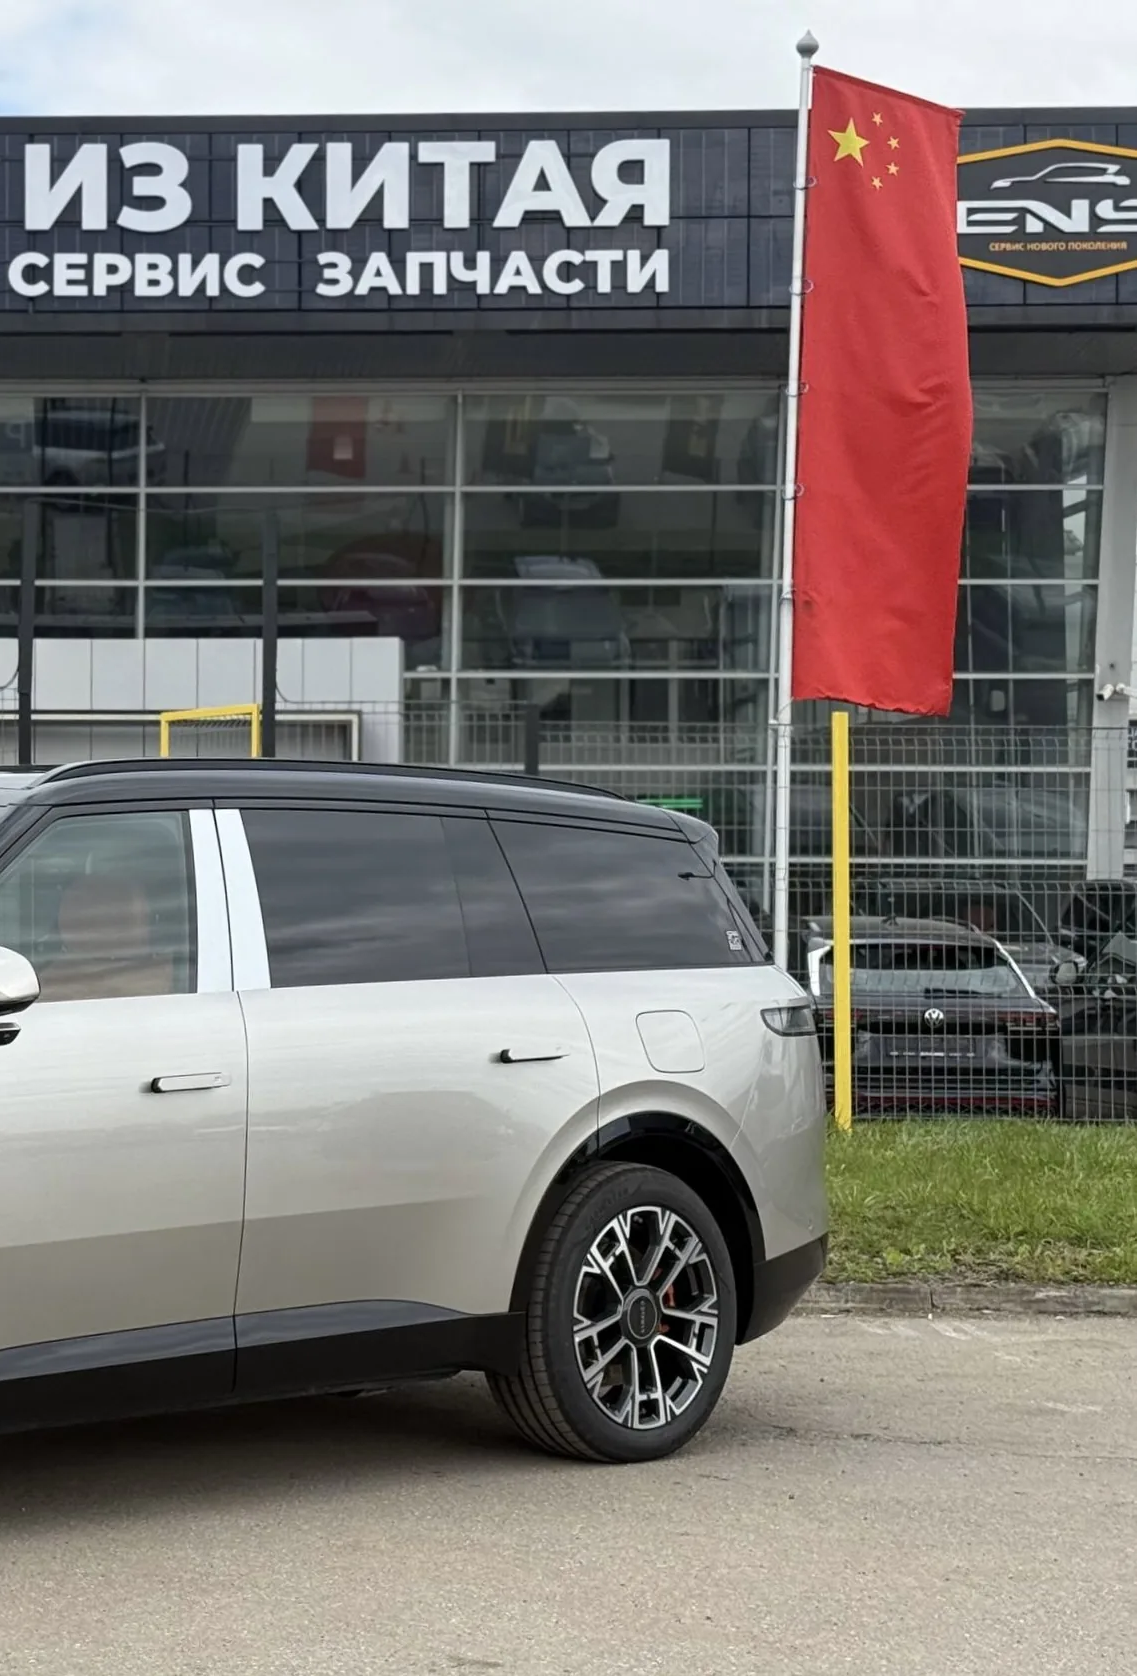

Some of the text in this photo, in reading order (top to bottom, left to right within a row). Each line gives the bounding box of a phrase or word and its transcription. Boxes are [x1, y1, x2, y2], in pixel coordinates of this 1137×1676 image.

[24, 142, 192, 232] ИЗ
[236, 138, 670, 231] КИТАЯ
[989, 241, 1127, 251] СЕРВИС НОВОГО ПОКОЛЕНИЯ
[7, 251, 266, 297] СЕРВИС
[315, 248, 669, 297] ЗАПЧАСТИ
